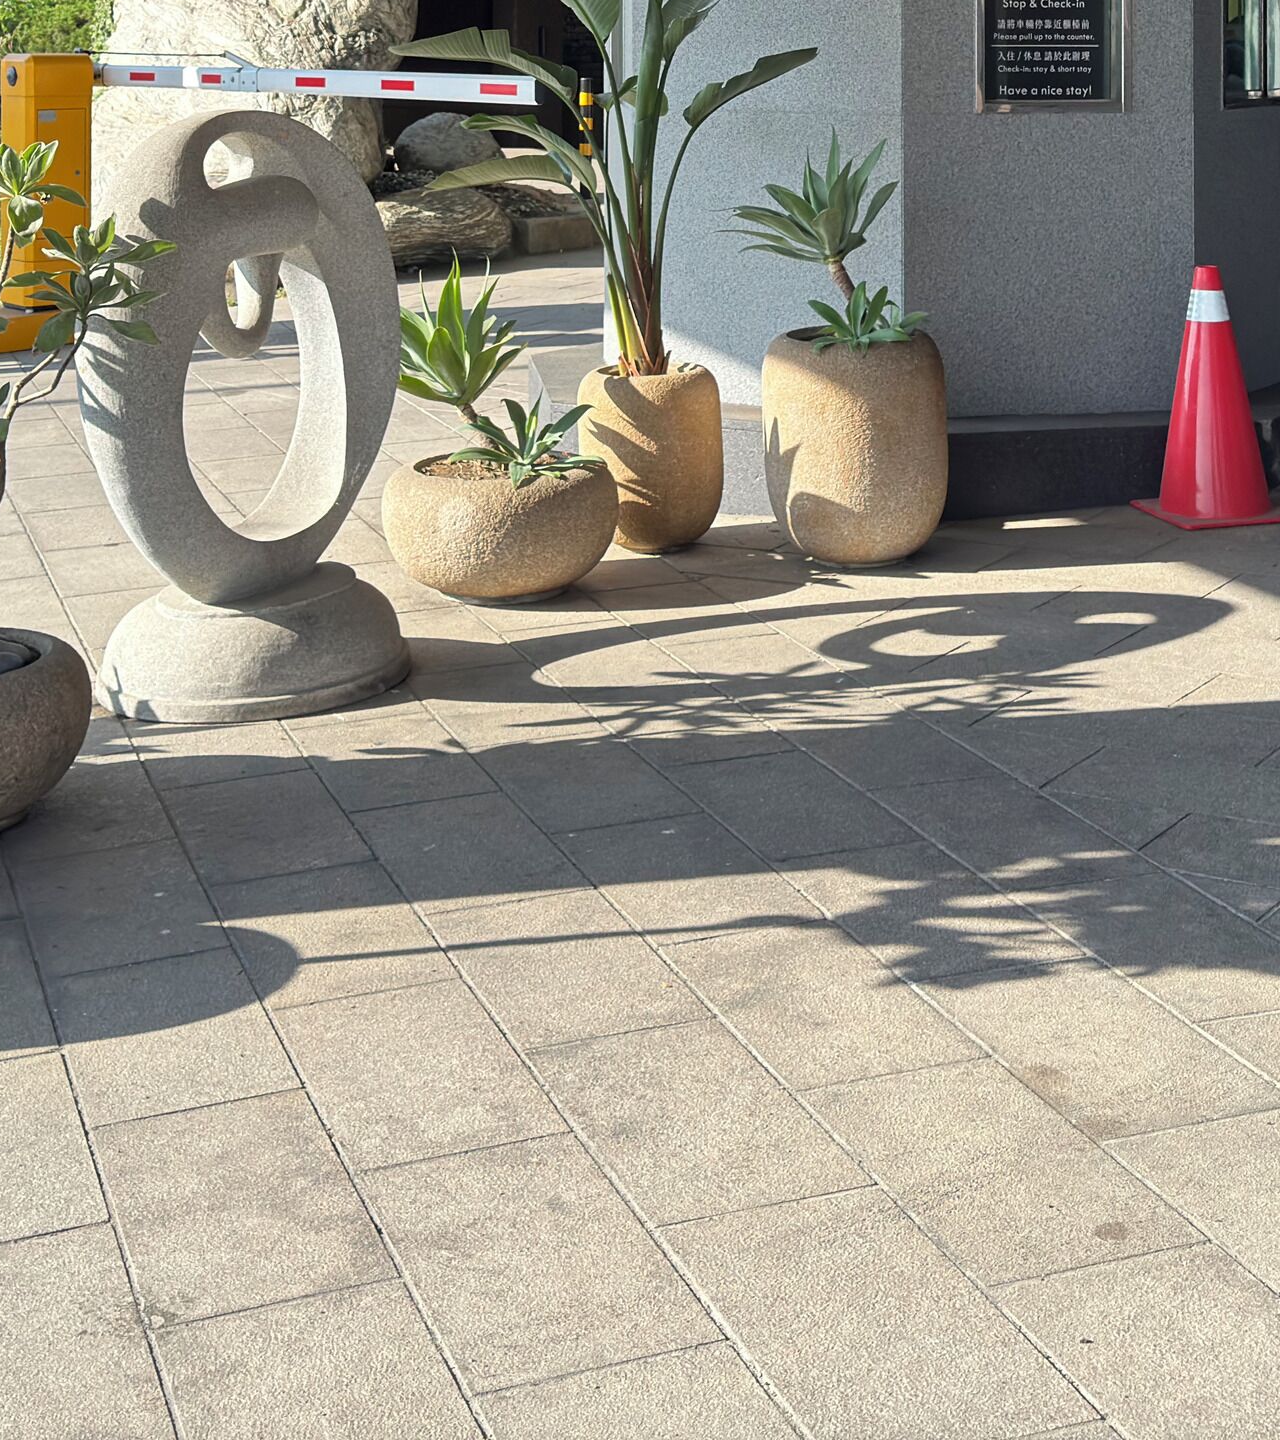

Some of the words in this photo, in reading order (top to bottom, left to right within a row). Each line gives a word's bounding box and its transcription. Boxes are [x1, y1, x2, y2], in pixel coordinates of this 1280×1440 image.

[993, 32, 1017, 40] Please
[1019, 33, 1033, 41] pull
[1033, 66, 1047, 74] stay
[1077, 66, 1092, 74] stay
[999, 85, 1028, 95] Have
[1041, 85, 1063, 95] nice
[1066, 85, 1092, 98] stay!
